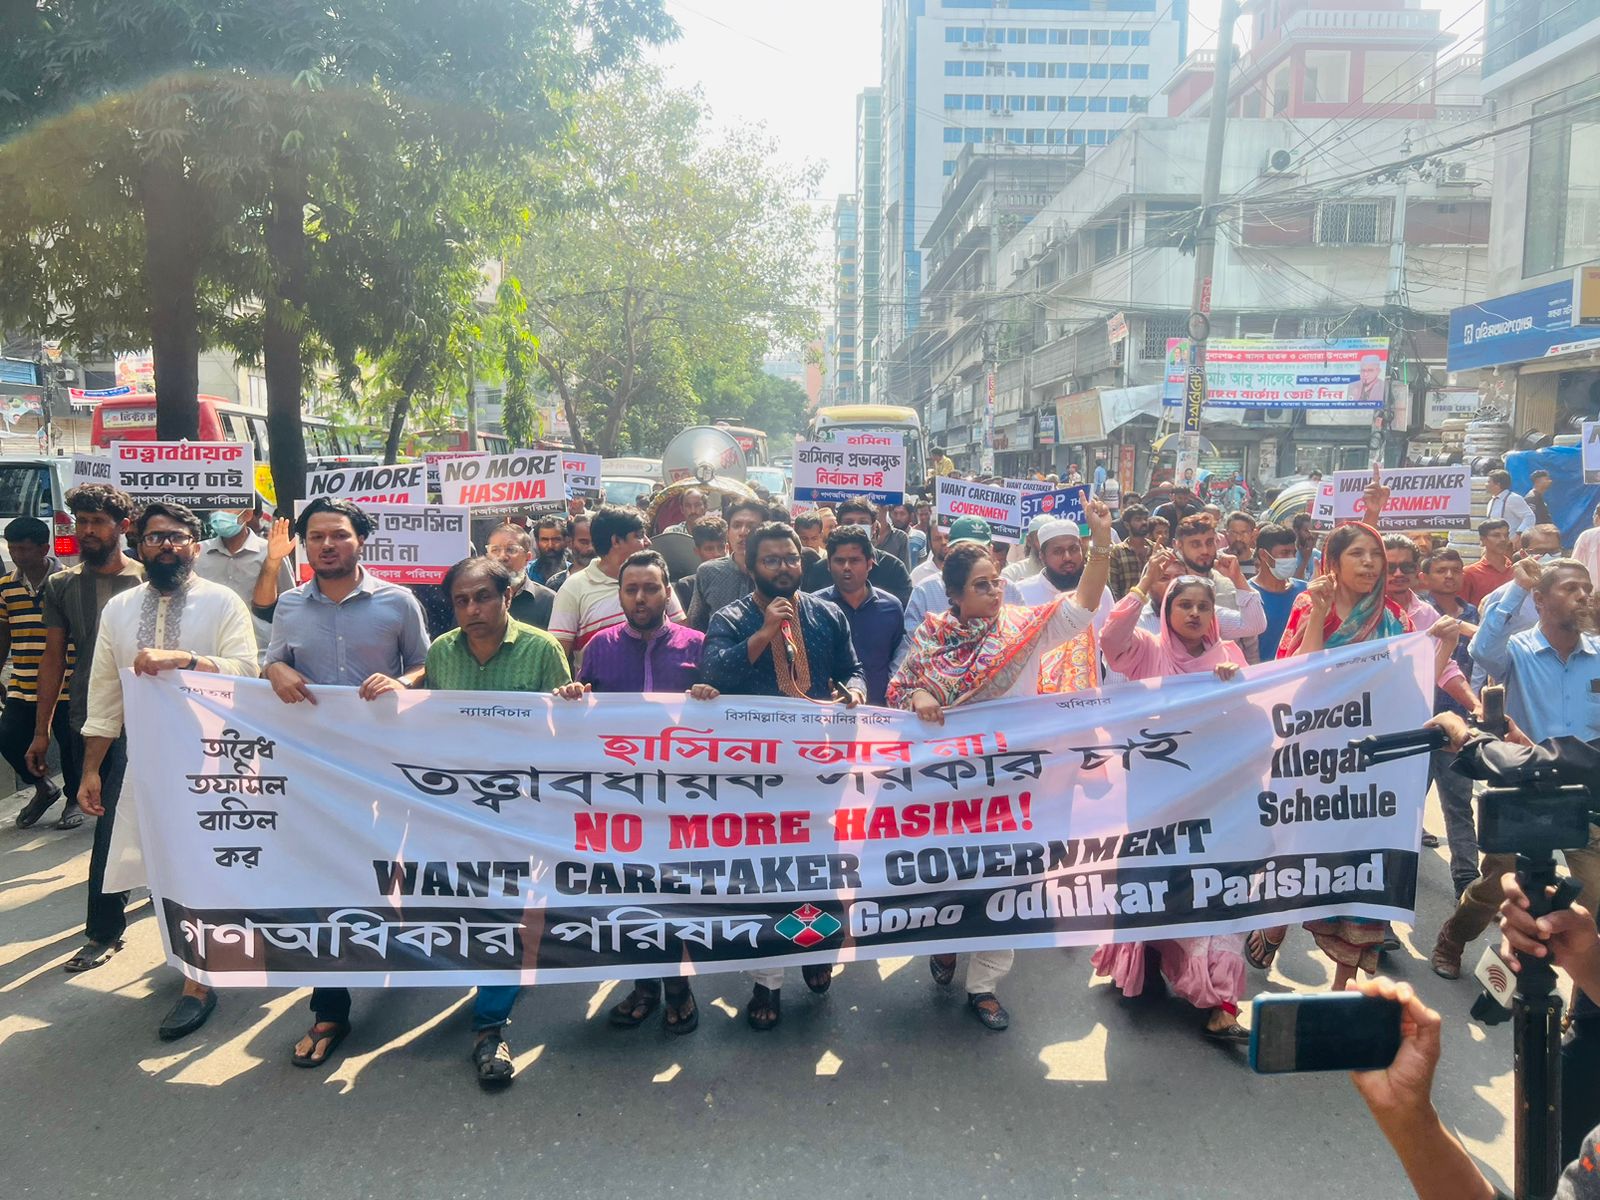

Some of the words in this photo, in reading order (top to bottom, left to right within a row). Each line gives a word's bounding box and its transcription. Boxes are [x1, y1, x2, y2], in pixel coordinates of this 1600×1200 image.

[847, 434, 892, 445] হাসিনা
[75, 460, 92, 476] WANT
[92, 462, 112, 479] CARET
[444, 460, 480, 482] NO
[485, 454, 558, 479] MORE
[798, 446, 844, 466] হাসিনার
[848, 452, 901, 472] প্রভাবমুক্ত
[119, 470, 201, 490] সরকার
[204, 468, 244, 488] চাই
[310, 472, 346, 496] NO
[349, 466, 424, 492] MORE
[816, 467, 859, 486] নির্বাচন
[863, 471, 884, 487] চাই
[1006, 481, 1022, 490] WANT
[1022, 483, 1054, 492] CARETAKER
[1339, 477, 1373, 493] WAN
[1383, 473, 1466, 491] CARETAKER
[206, 494, 250, 505] পরিষদ
[459, 479, 546, 504] HASINA
[940, 481, 967, 497] WANT
[968, 486, 1018, 506] CARETAKER
[1070, 498, 1081, 506] TH
[949, 500, 1009, 521] GOVERNMENT
[1353, 495, 1451, 513] GERNMENT
[384, 508, 463, 532] তফসিল
[993, 525, 1019, 535] পরিষদ
[1422, 515, 1467, 526] পরিষদ
[398, 543, 419, 562] না
[405, 569, 444, 579] পরিষদ
[459, 705, 533, 718] ন্যায়বিচার
[1055, 696, 1112, 711] অধিকার
[1272, 692, 1372, 738] Cancel
[725, 708, 796, 723] বিসমিল্লাহির
[801, 710, 857, 725] রাহমানির
[861, 711, 892, 726] রাহিম
[201, 728, 276, 761] অবৈধ
[598, 726, 783, 766] হাসিনা
[792, 740, 915, 765] আর
[922, 731, 1008, 757] না!
[816, 749, 1053, 795] সরকার
[1069, 728, 1193, 772] চাই
[1271, 743, 1366, 784] Illegal
[186, 760, 288, 795] তফসিল
[197, 796, 278, 831] বাতিল
[1257, 783, 1396, 827] Schedule
[574, 812, 643, 853] NO
[668, 810, 810, 850] MORE
[834, 791, 1034, 841] HASINA!
[213, 846, 263, 869] কর
[372, 859, 530, 898] WANT
[555, 853, 863, 897] CARETAKER
[885, 818, 1212, 886] GOVERNMENT
[848, 900, 965, 938] Gono
[985, 868, 1170, 922] Odhikar
[1191, 853, 1385, 909] Parishad
[179, 908, 527, 959] গণঅধিকার
[550, 906, 773, 953] পরিষদ
